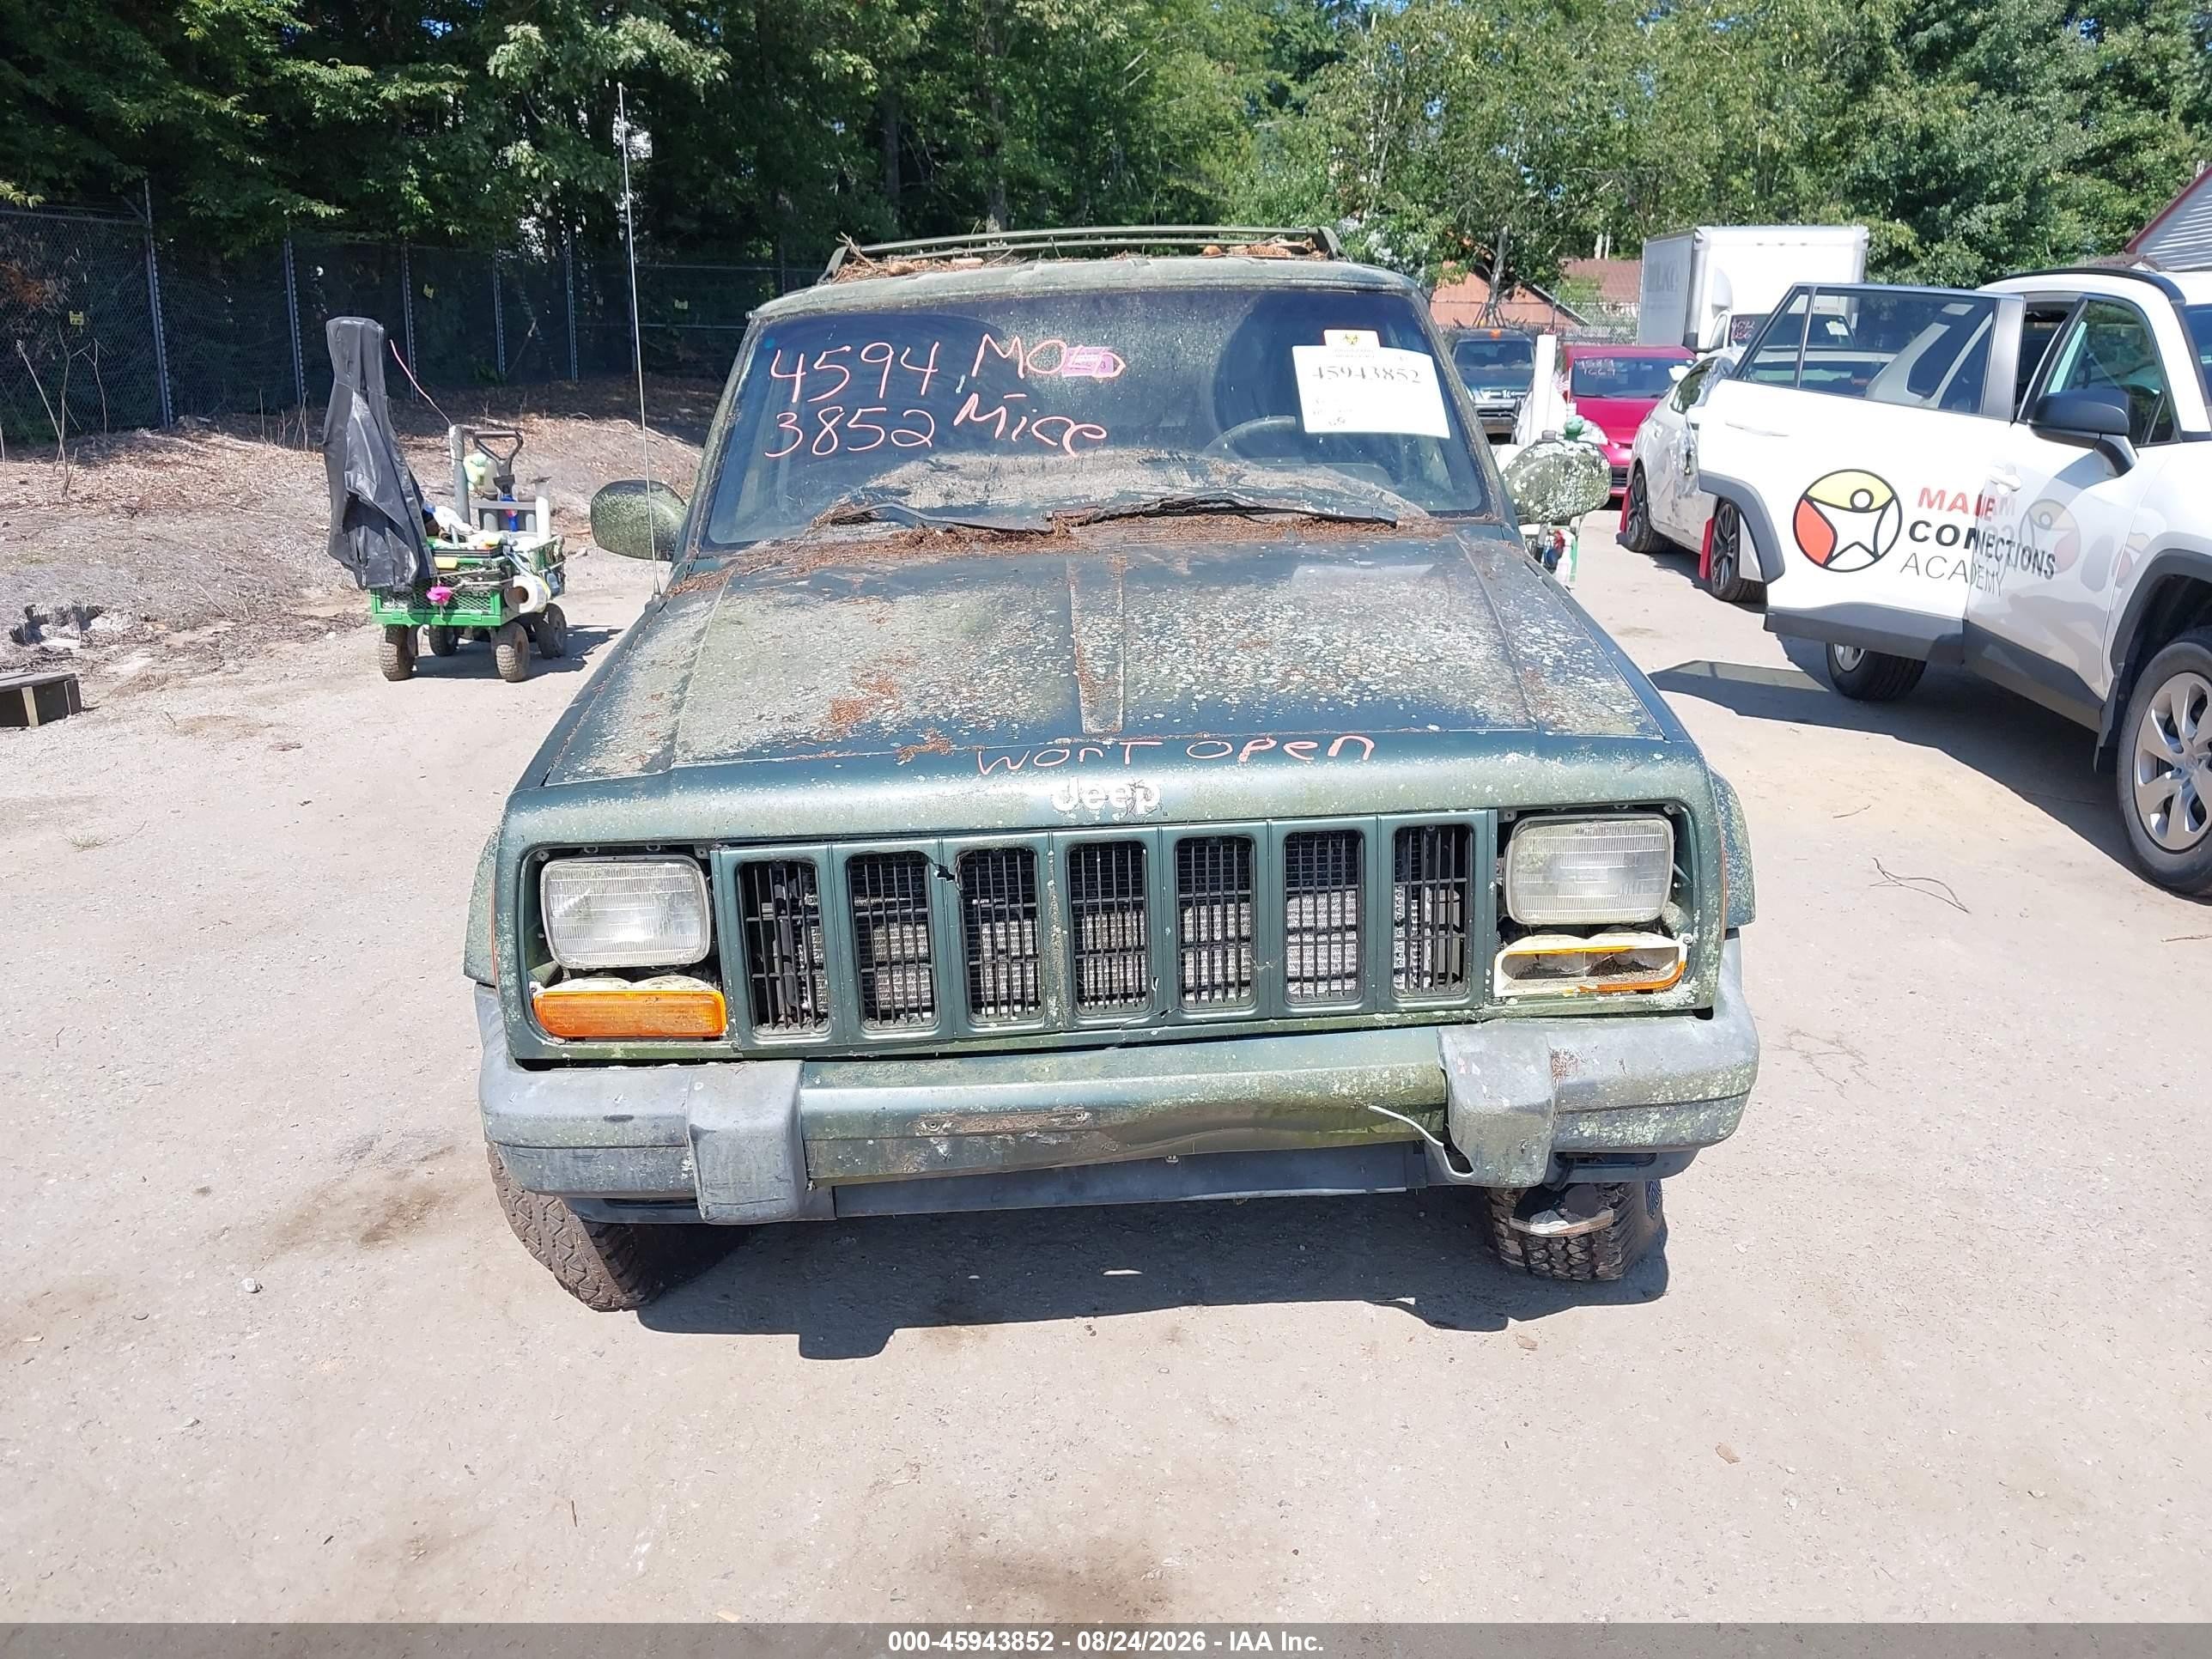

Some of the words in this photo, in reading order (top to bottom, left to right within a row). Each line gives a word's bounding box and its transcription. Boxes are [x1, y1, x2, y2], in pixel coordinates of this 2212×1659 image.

[770, 342, 939, 403] 4594
[1312, 366, 1421, 384] 45943852
[764, 406, 935, 458] 3852
[1909, 520, 2057, 580] CONNECTIONS
[1899, 552, 2007, 598] ACADEMY
[1052, 776, 1162, 816] Jeep
